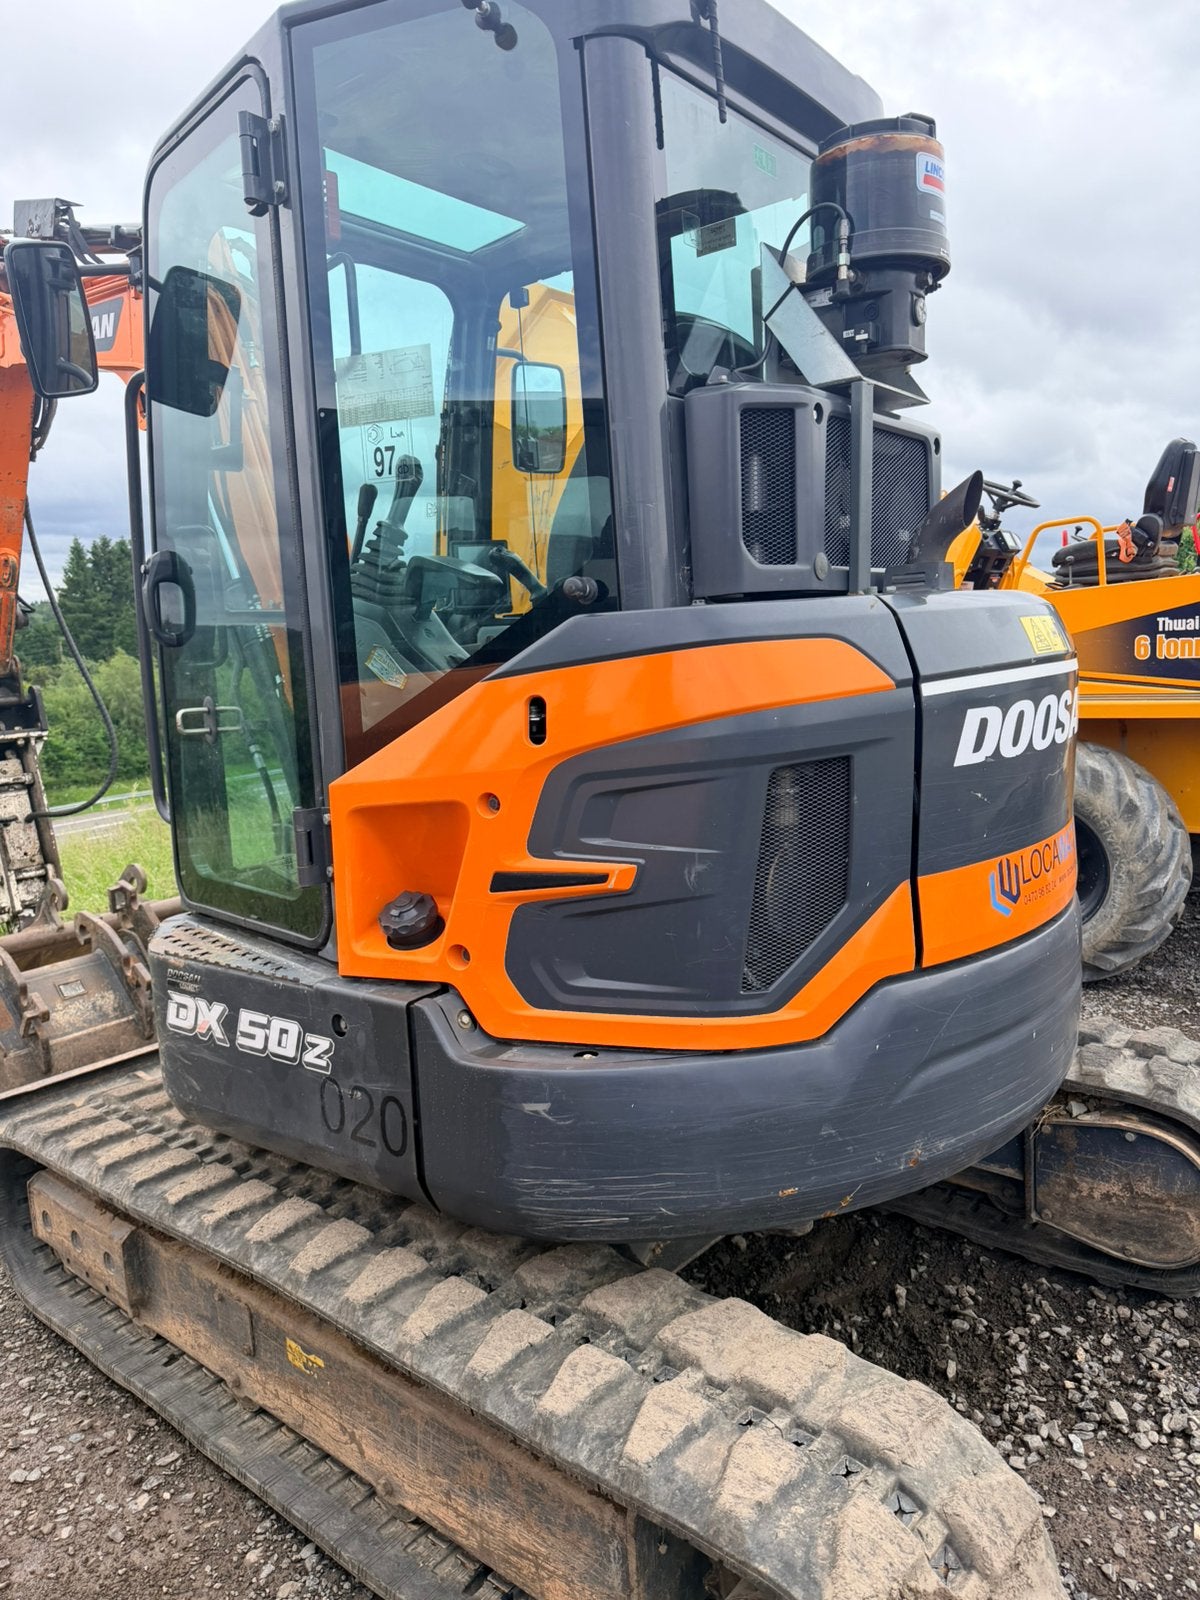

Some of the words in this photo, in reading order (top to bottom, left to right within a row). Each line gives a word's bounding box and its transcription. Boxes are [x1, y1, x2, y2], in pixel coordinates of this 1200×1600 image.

[374, 445, 395, 477] 97
[1134, 634, 1151, 660] 6
[166, 990, 231, 1047] DX
[320, 1077, 408, 1157] 020
